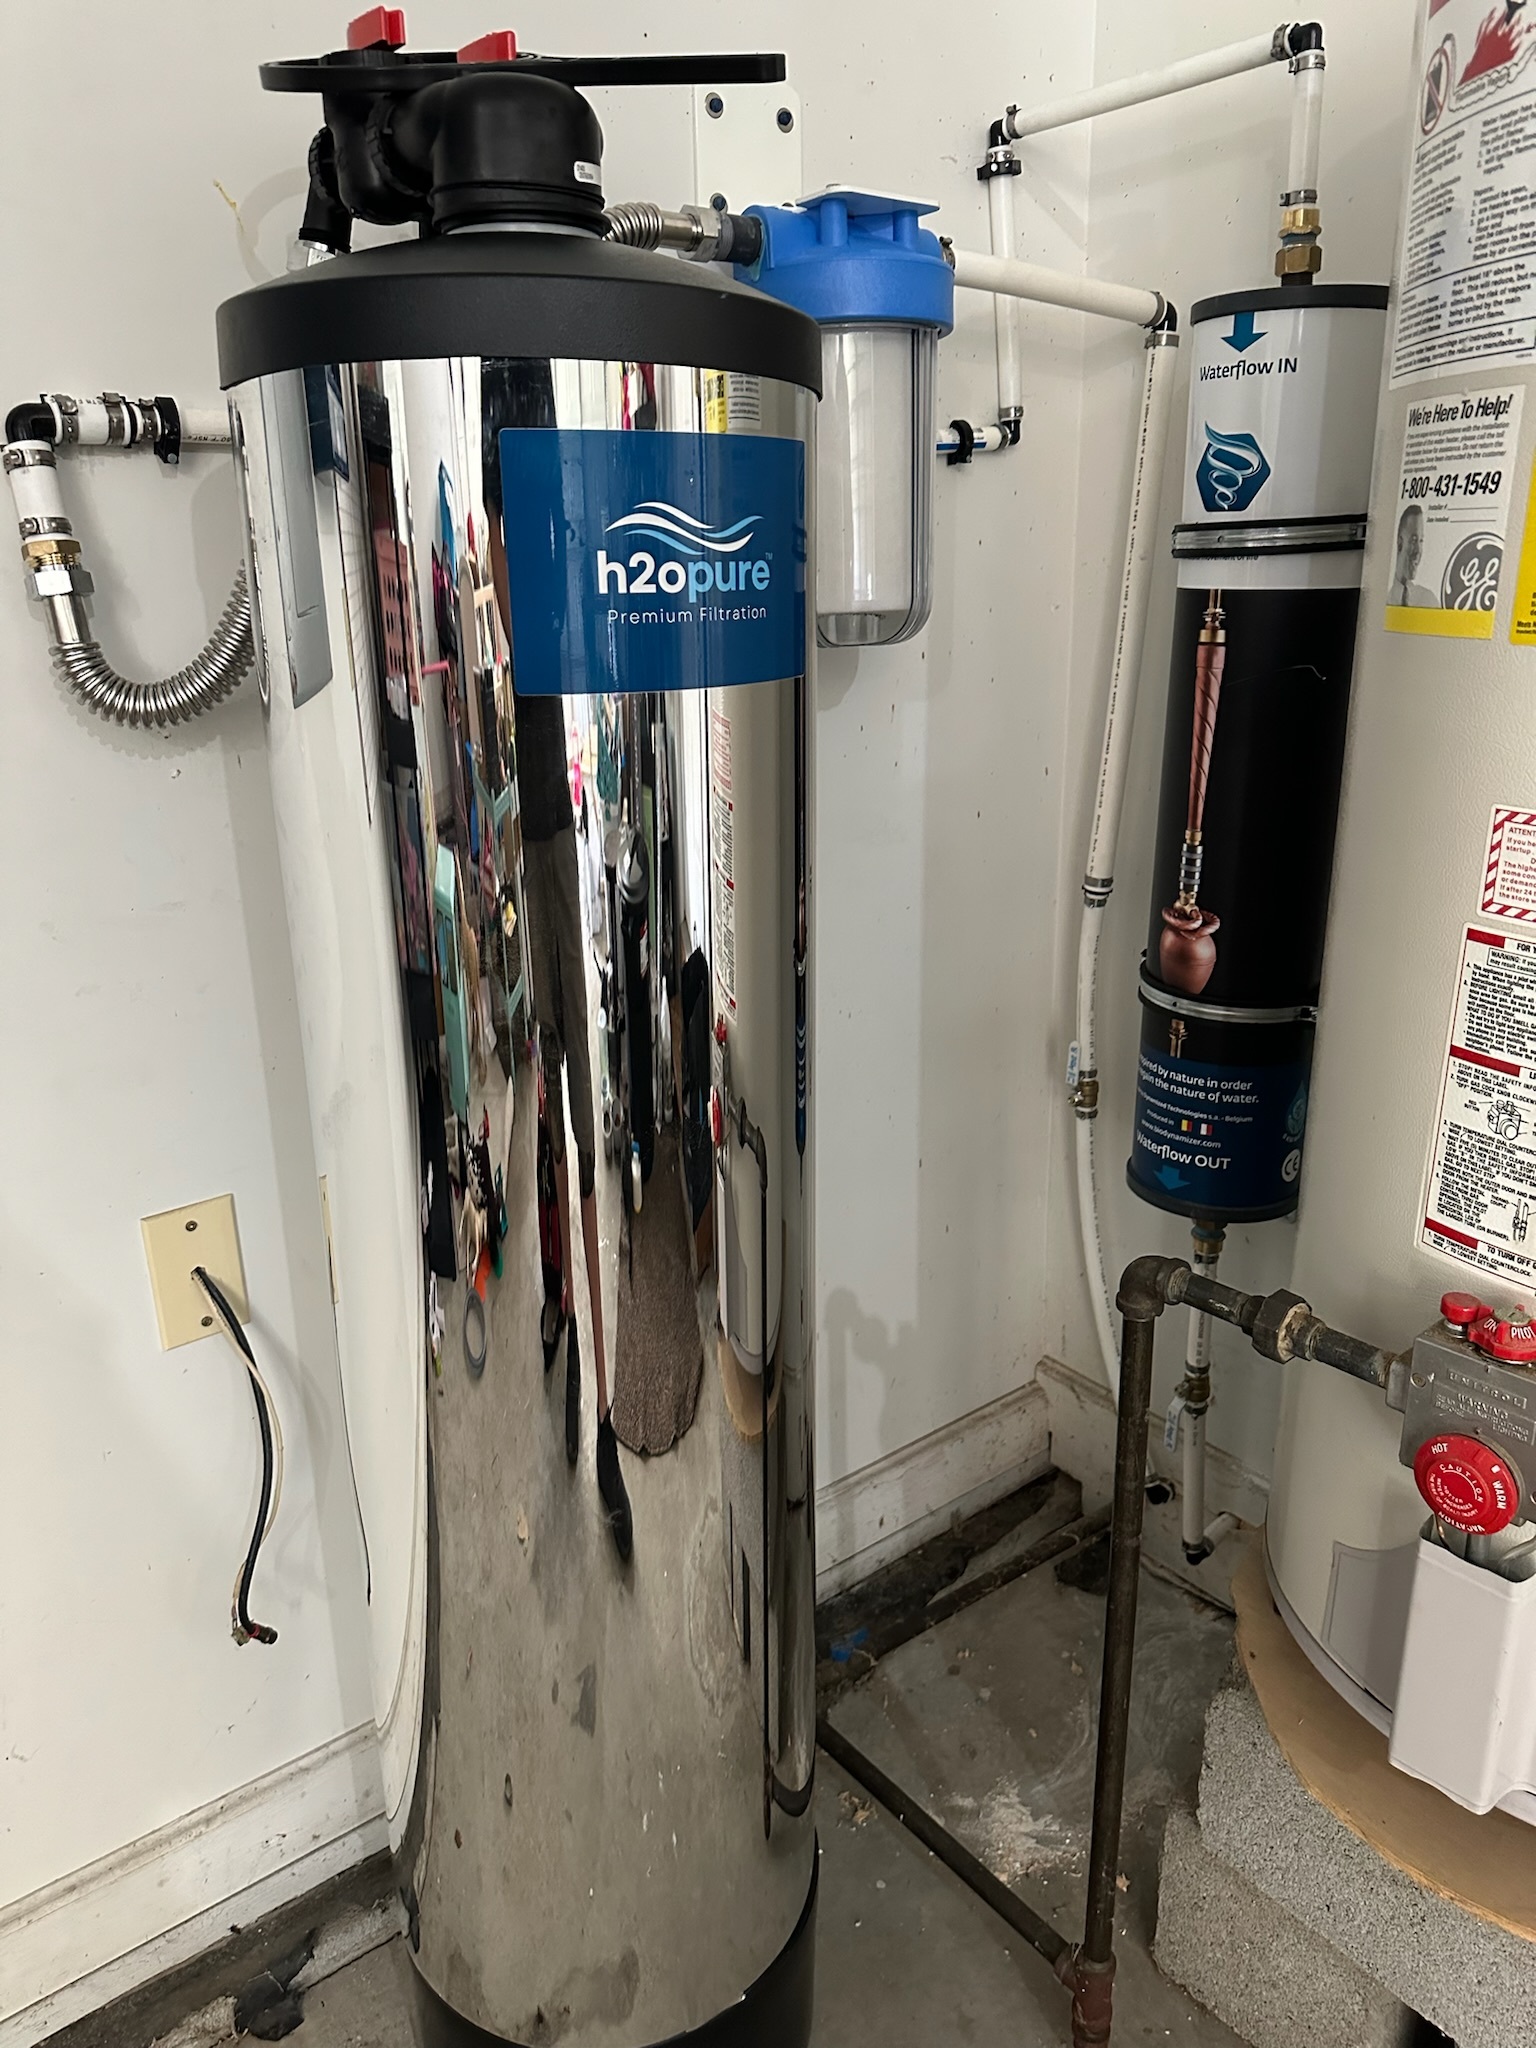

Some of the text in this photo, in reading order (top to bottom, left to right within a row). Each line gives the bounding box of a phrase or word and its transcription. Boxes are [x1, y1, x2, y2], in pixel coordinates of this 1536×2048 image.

[1200, 358, 1297, 381] Waterflow IN
[1408, 394, 1514, 427] We're Here To Help!
[1401, 471, 1502, 499] 1-800-431-1549
[597, 550, 770, 603] h2opure
[1460, 557, 1499, 611] GE
[608, 605, 766, 624] Premium Filtration
[1506, 885, 1522, 895] after
[1511, 894, 1529, 904] store
[1491, 950, 1521, 964] WARNING:
[1517, 942, 1531, 953] FOR
[1158, 1065, 1167, 1079] by
[1170, 1071, 1204, 1087] nature
[1207, 1077, 1218, 1088] in
[1220, 1080, 1252, 1090] order
[1155, 1078, 1169, 1091] the
[1171, 1082, 1206, 1100] nature
[1208, 1092, 1220, 1103] of
[1222, 1093, 1259, 1104] water.
[1194, 1155, 1231, 1170] OUT
[1487, 1245, 1531, 1268] TO TURN OFF
[1484, 1318, 1498, 1333] ON
[1511, 1326, 1536, 1339] PILOT
[1450, 1373, 1522, 1407] UNITROL
[1458, 1393, 1509, 1419] WARNING
[1431, 1443, 1448, 1454] HOT
[1439, 1464, 1484, 1503] CAUTION
[1438, 1512, 1485, 1532] VACATION
